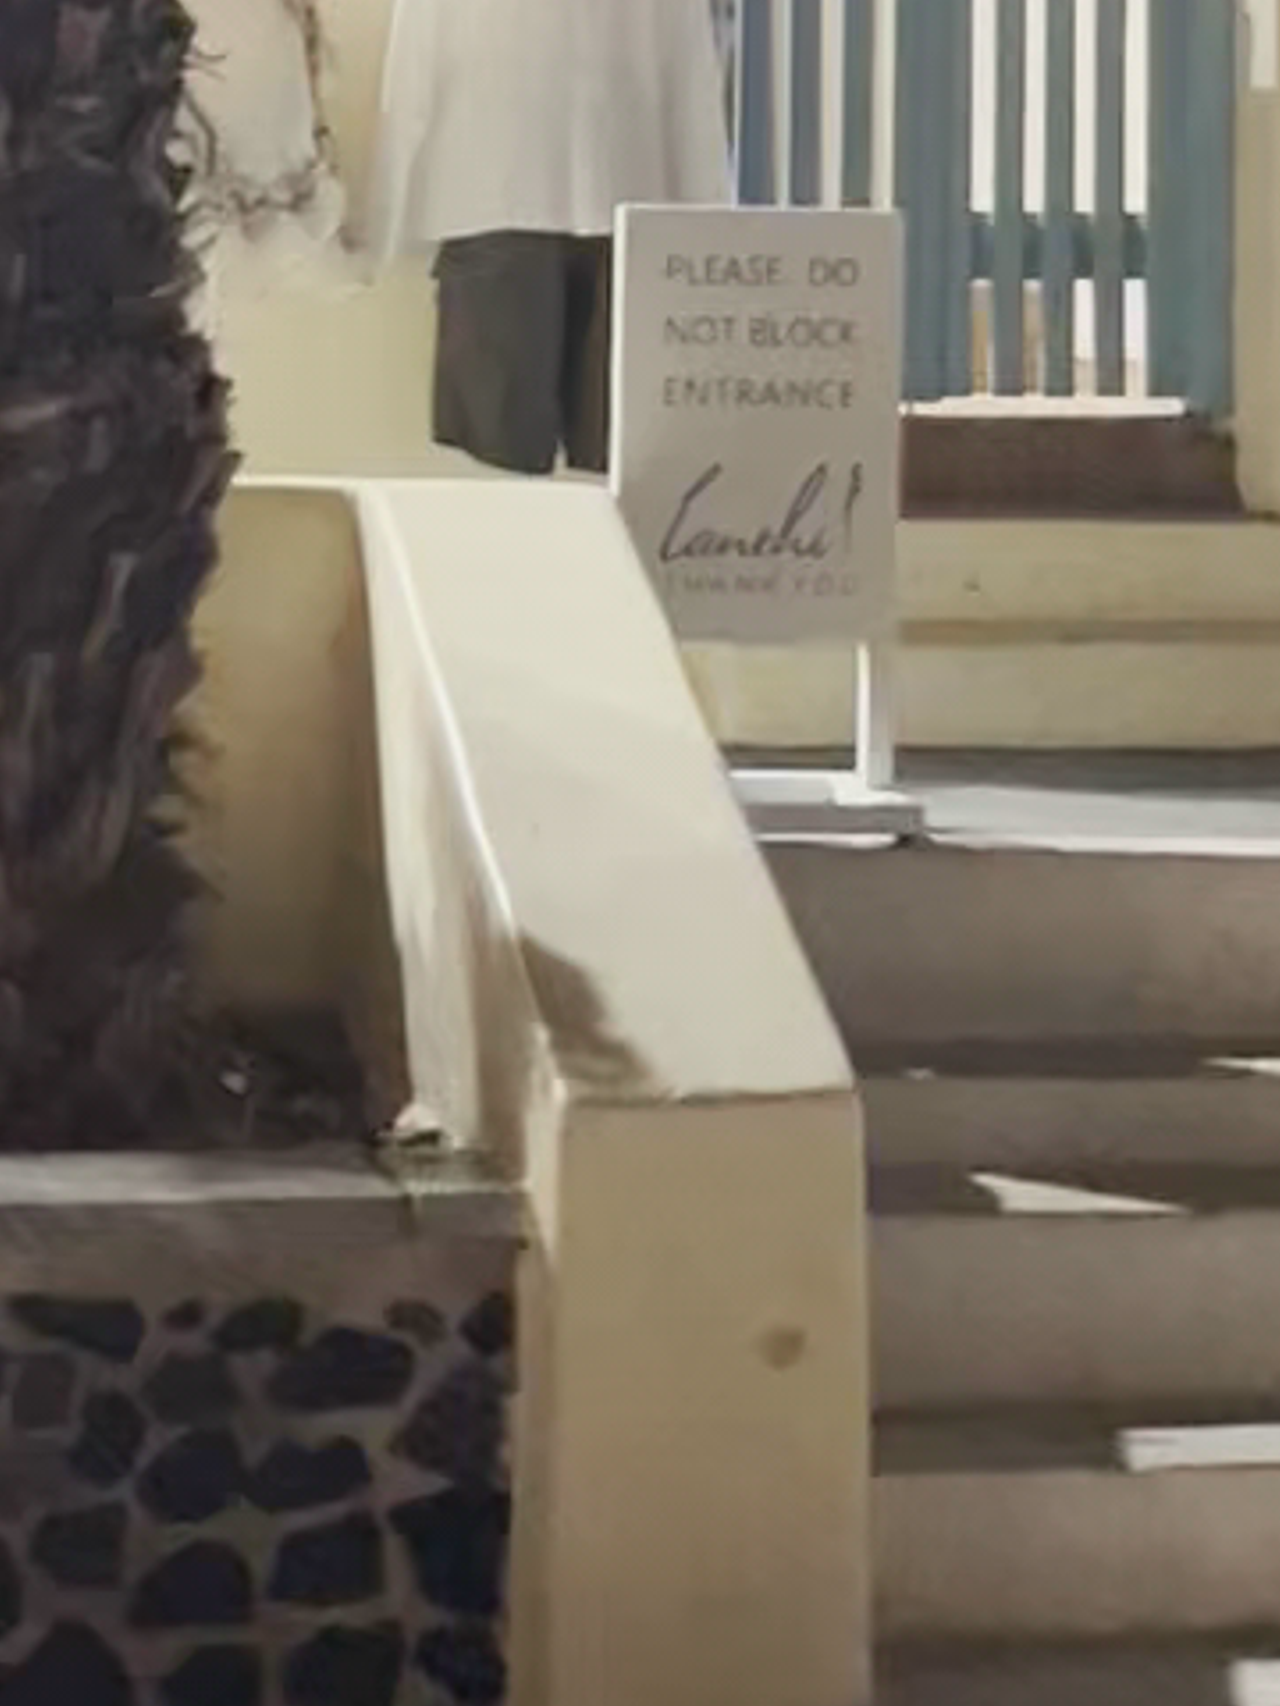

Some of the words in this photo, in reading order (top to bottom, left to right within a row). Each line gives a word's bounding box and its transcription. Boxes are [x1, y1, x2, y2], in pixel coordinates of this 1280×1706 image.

[663, 254, 783, 287] PLEASE
[807, 255, 860, 288] DO
[663, 315, 736, 347] NOT
[749, 314, 857, 349] BLOCK
[662, 376, 854, 409] ENTRANCE
